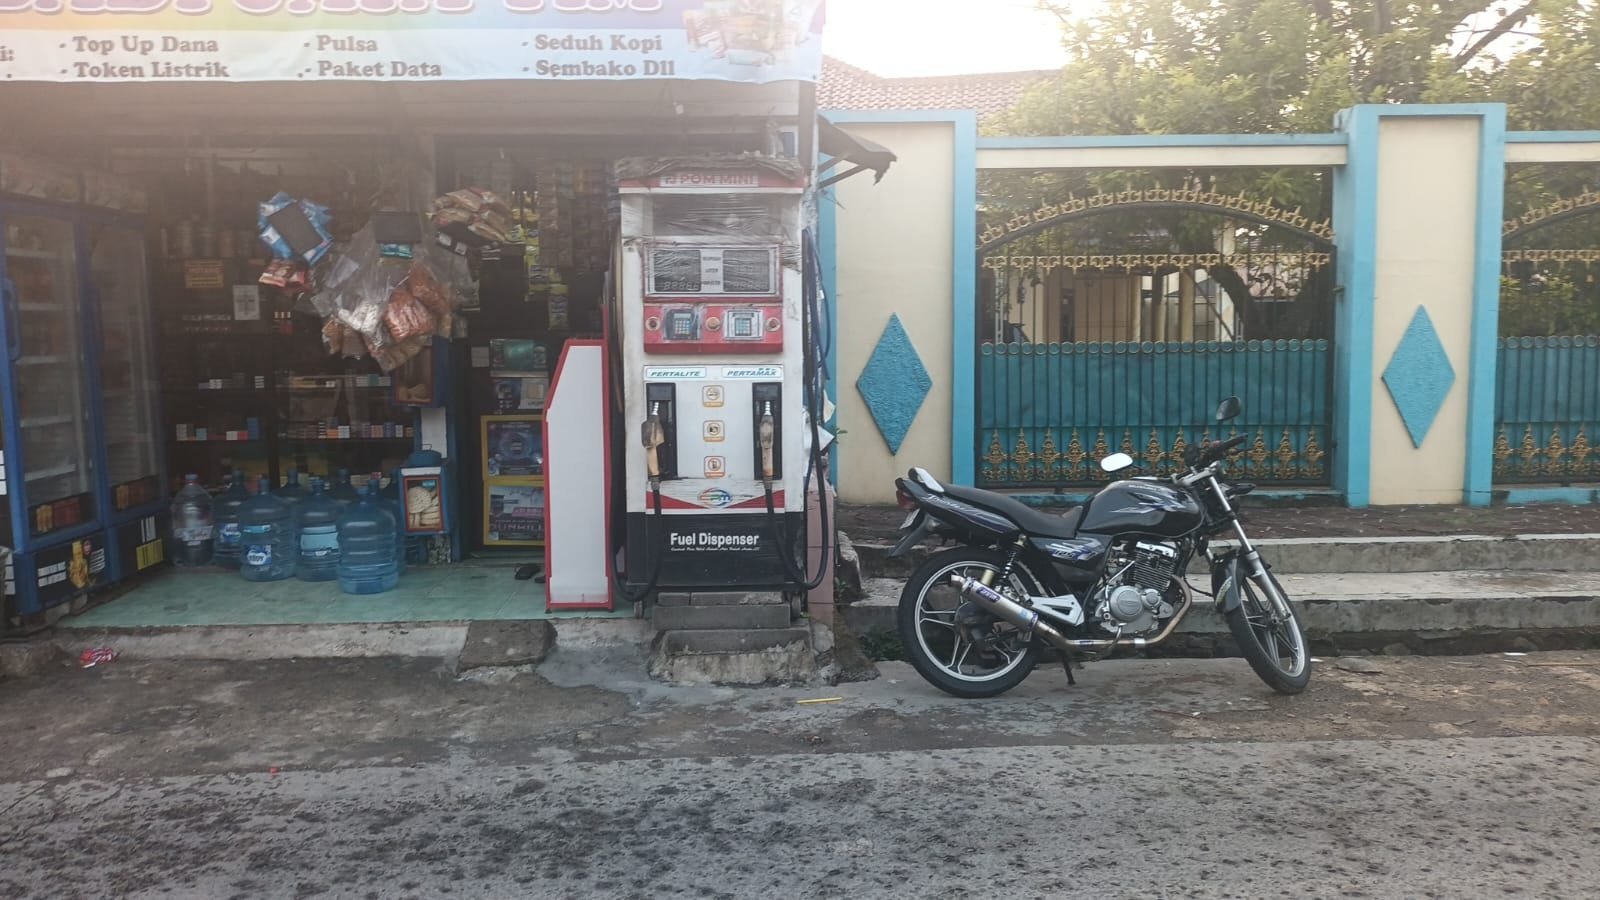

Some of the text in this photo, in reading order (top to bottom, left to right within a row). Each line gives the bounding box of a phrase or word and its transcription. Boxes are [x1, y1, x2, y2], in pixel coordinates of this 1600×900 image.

[72, 35, 219, 55] Top Up Dana
[317, 35, 378, 52] Pulsa
[535, 34, 662, 54] Seduh Kopi
[74, 62, 229, 78] Token Listrik
[318, 61, 442, 77] Paket Data
[536, 60, 636, 77] Sembako
[671, 533, 760, 548] Fuel Dispenser
